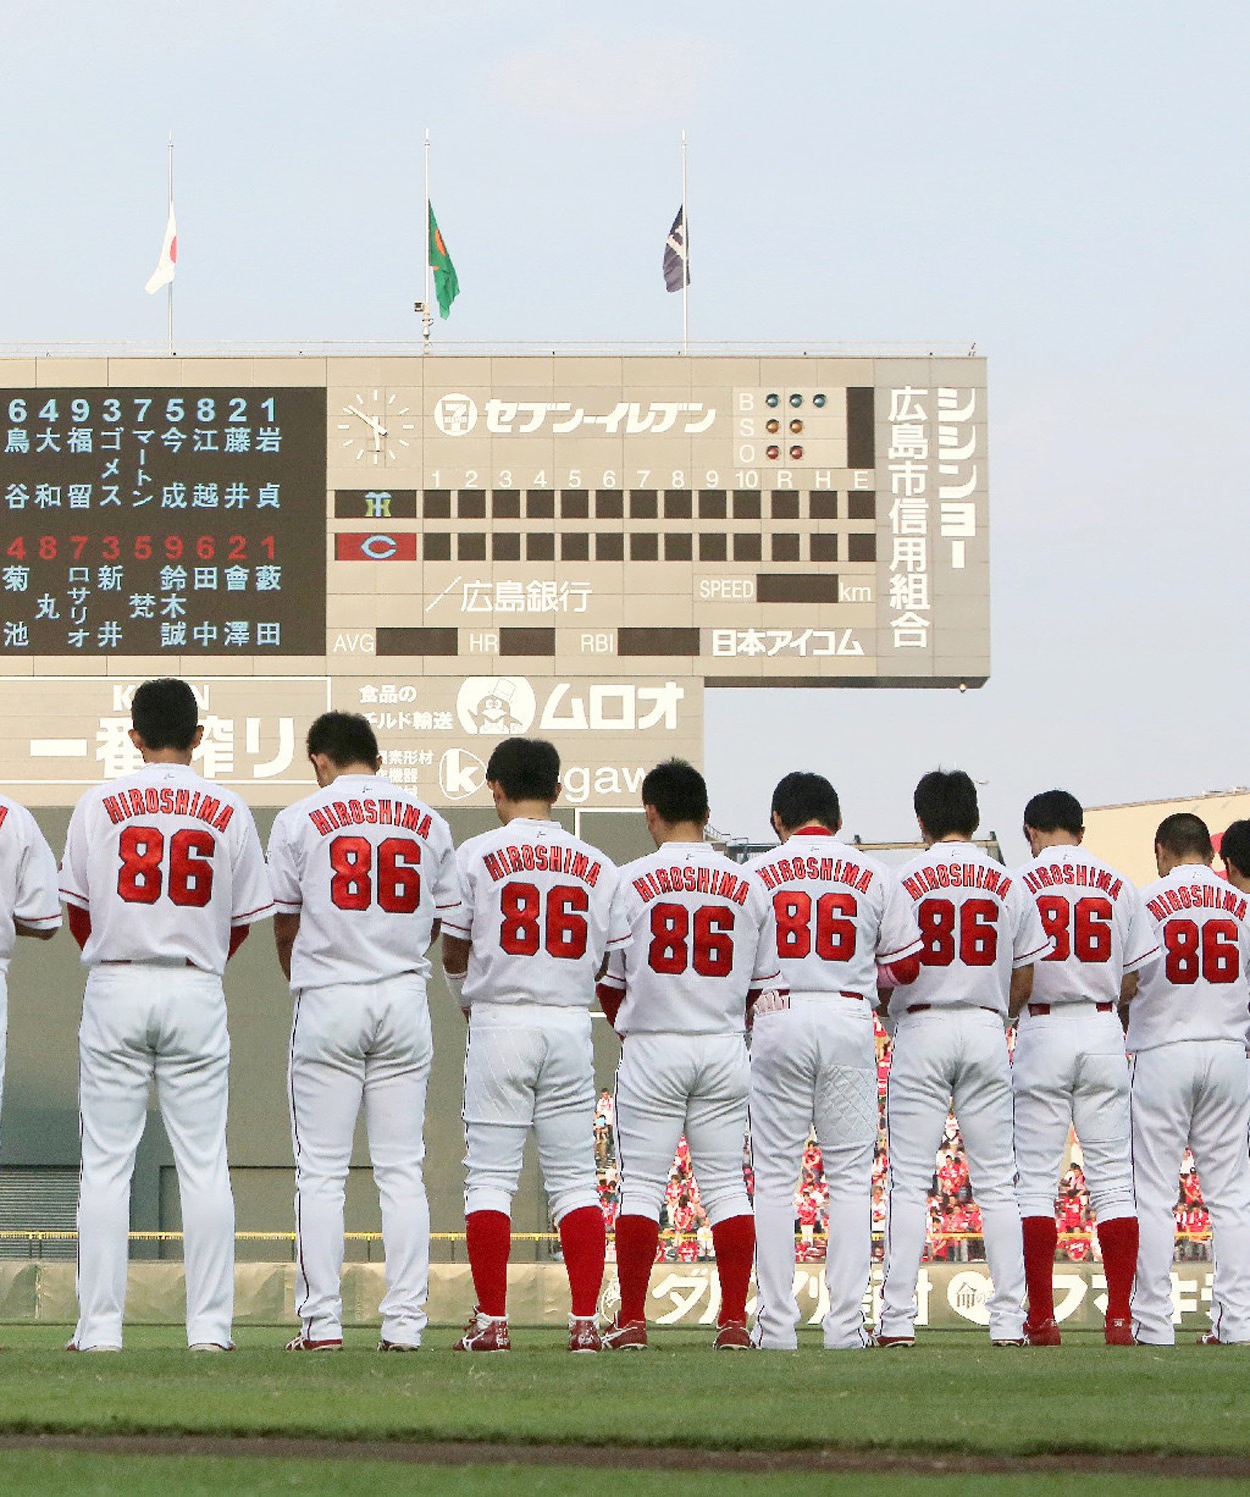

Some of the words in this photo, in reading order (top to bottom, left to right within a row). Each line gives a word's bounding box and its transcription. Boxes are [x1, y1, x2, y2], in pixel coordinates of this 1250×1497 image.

[7, 398, 28, 423] 6
[38, 398, 60, 423] 4
[70, 398, 90, 423] 9
[102, 398, 122, 423] 3
[133, 398, 153, 423] 7
[165, 398, 185, 423] 5
[196, 397, 216, 423] 8
[228, 397, 248, 423] 2
[260, 397, 276, 423] 1
[739, 393, 754, 411] B
[740, 418, 754, 437] S
[4, 427, 30, 509] 鳥谷
[35, 427, 62, 509] 大和
[67, 427, 93, 509] 福留
[99, 427, 123, 507] ゴメス
[131, 429, 154, 507] マートン
[161, 427, 188, 509] 今成
[193, 427, 220, 508] 江越
[224, 427, 252, 508] 藤井
[255, 427, 283, 509] 岩貞
[739, 444, 755, 463] O
[432, 470, 441, 487] 1
[465, 470, 478, 487] 2
[499, 470, 512, 487] 3
[533, 470, 547, 488] 4
[568, 470, 582, 488] 5
[603, 470, 616, 488] 6
[637, 470, 650, 488] 7
[672, 471, 685, 488] 8
[706, 471, 719, 488] 9
[735, 471, 758, 488] 10
[777, 471, 792, 488] R
[815, 471, 831, 488] H
[854, 471, 868, 488] E
[937, 388, 977, 569] シシンヨー
[887, 386, 931, 648] 広島市信用組合
[6, 535, 27, 560] 4
[38, 535, 58, 560] 8
[70, 535, 89, 560] 7
[102, 535, 121, 560] 3
[134, 535, 153, 560] 5
[165, 535, 184, 560] 9
[196, 535, 215, 560] 6
[228, 535, 248, 560] 2
[261, 535, 275, 560] 1
[2, 565, 31, 647] 菊池
[35, 593, 61, 620] 丸
[68, 567, 91, 647] ロサリオ
[97, 565, 124, 647] 新井
[129, 593, 156, 619] 梵
[160, 565, 187, 647] 鈴木誠
[193, 566, 218, 647] 田中
[460, 579, 593, 613] 広島銀行
[700, 580, 755, 598] SPEED
[838, 582, 871, 602] km
[333, 633, 375, 652] AVG
[469, 634, 498, 652] HR
[580, 634, 614, 652] RBI
[712, 628, 865, 656] 日本アイコム
[358, 684, 418, 704] 食品の
[539, 681, 685, 730] ムロオ
[103, 788, 235, 834] HIROSHIMA
[309, 799, 433, 840] HIROSHIMA
[116, 825, 217, 908] 86
[329, 834, 422, 914] 86
[483, 844, 602, 889] HIROSHIMA
[632, 866, 751, 906] HIROSHIMA
[756, 857, 874, 894] HIROSHIMA
[902, 863, 1013, 901] HIROSHIMA
[499, 882, 590, 960] 86
[771, 889, 859, 962] 86
[1146, 884, 1249, 922] HIROSHIMA
[647, 902, 736, 978] 86
[916, 897, 1000, 967] 86
[1162, 918, 1241, 985] 86
